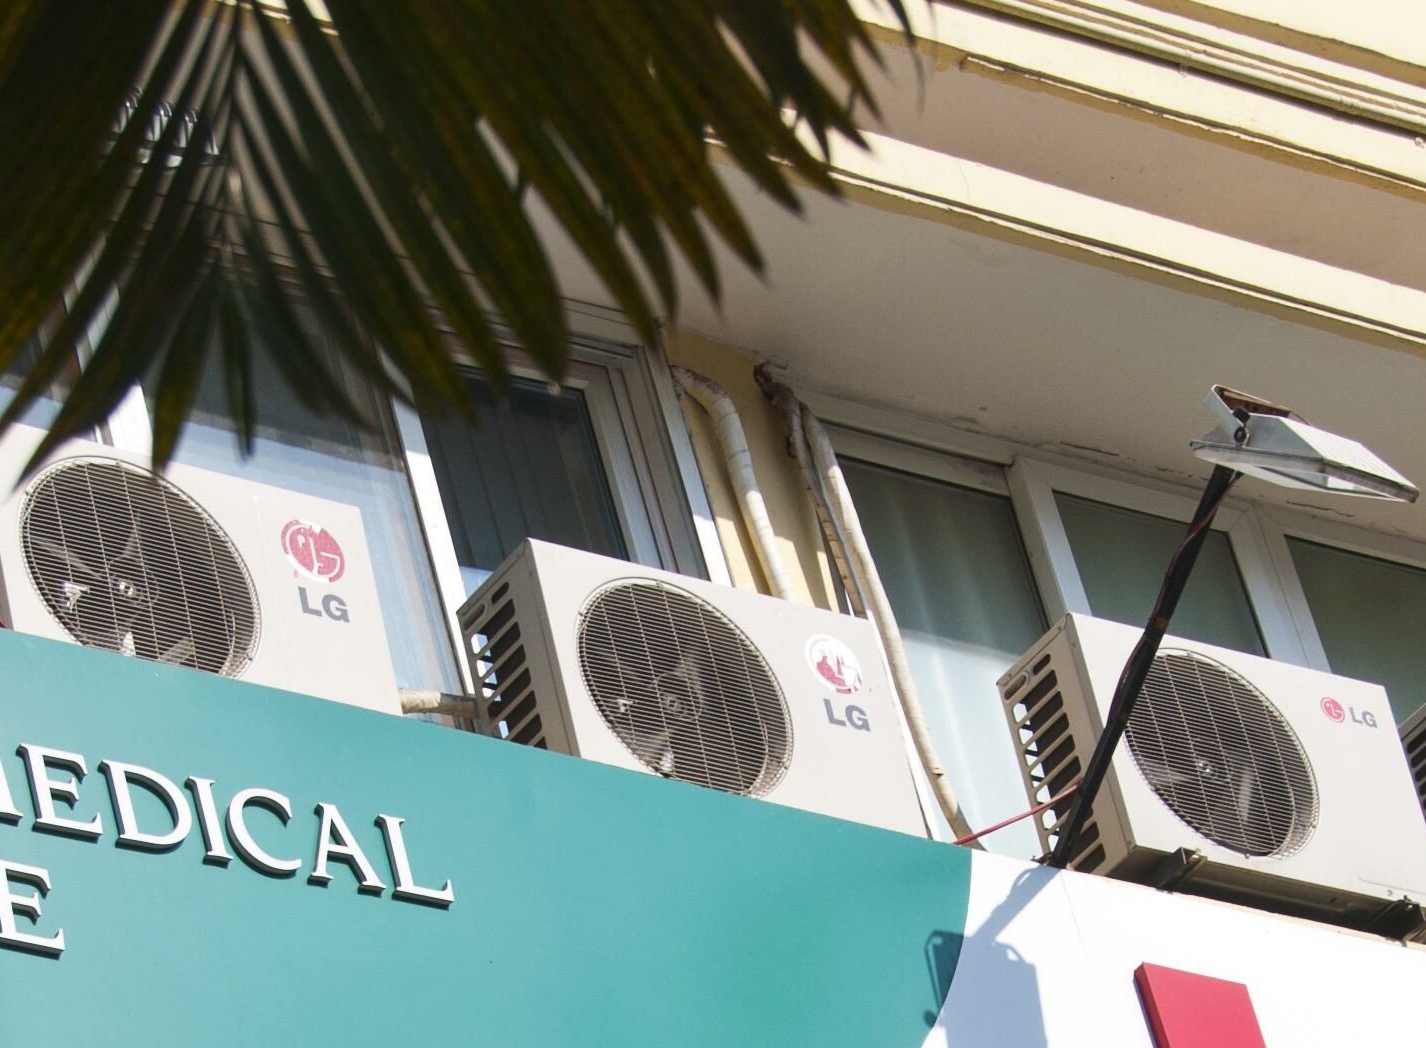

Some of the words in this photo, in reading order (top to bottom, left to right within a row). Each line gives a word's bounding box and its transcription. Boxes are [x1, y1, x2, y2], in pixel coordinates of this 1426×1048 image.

[298, 586, 350, 623] LG
[823, 698, 871, 732] LG
[1349, 706, 1378, 728] LG
